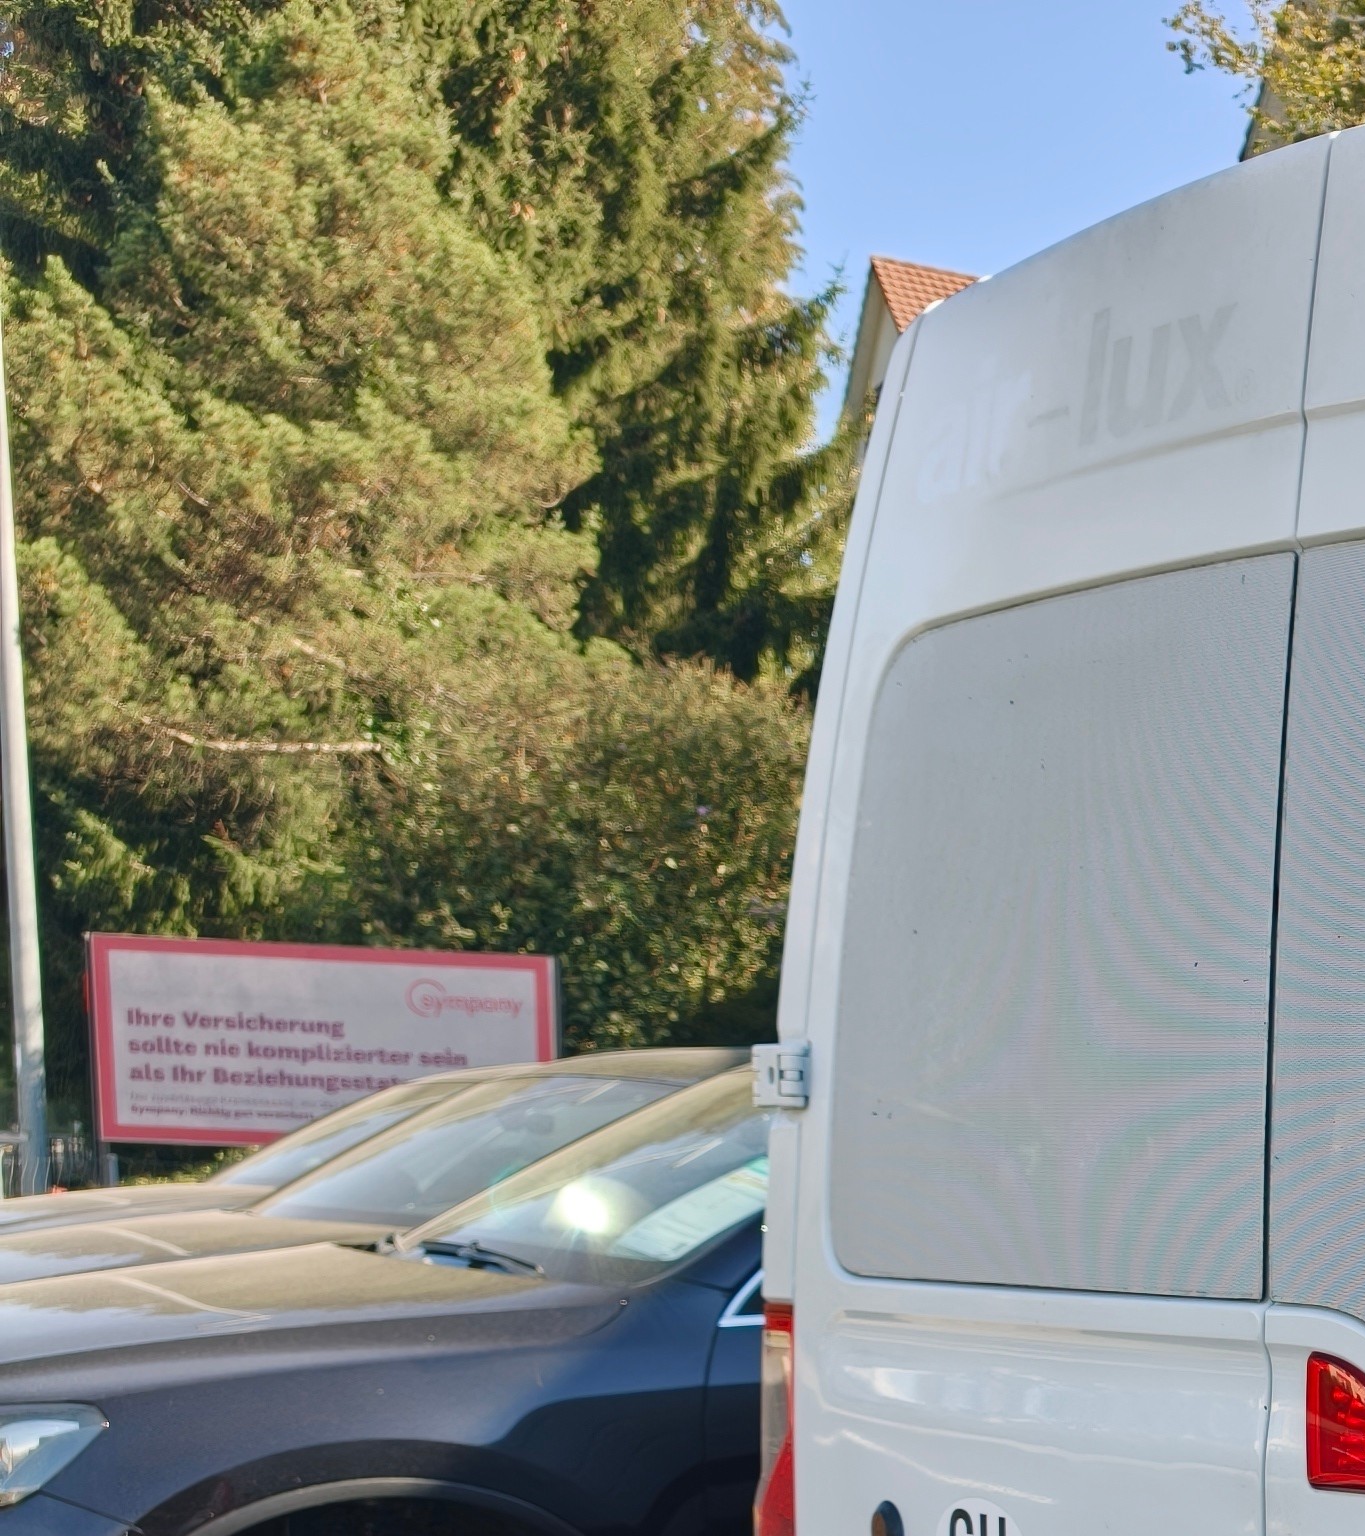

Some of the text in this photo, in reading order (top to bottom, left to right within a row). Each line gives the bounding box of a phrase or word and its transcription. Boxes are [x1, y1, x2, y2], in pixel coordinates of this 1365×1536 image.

[127, 1008, 345, 1038] Ihre Versicherung
[128, 1036, 468, 1067] sollte nie komplizierter sein
[129, 1063, 165, 1082] als
[172, 1064, 206, 1083] Ihr
